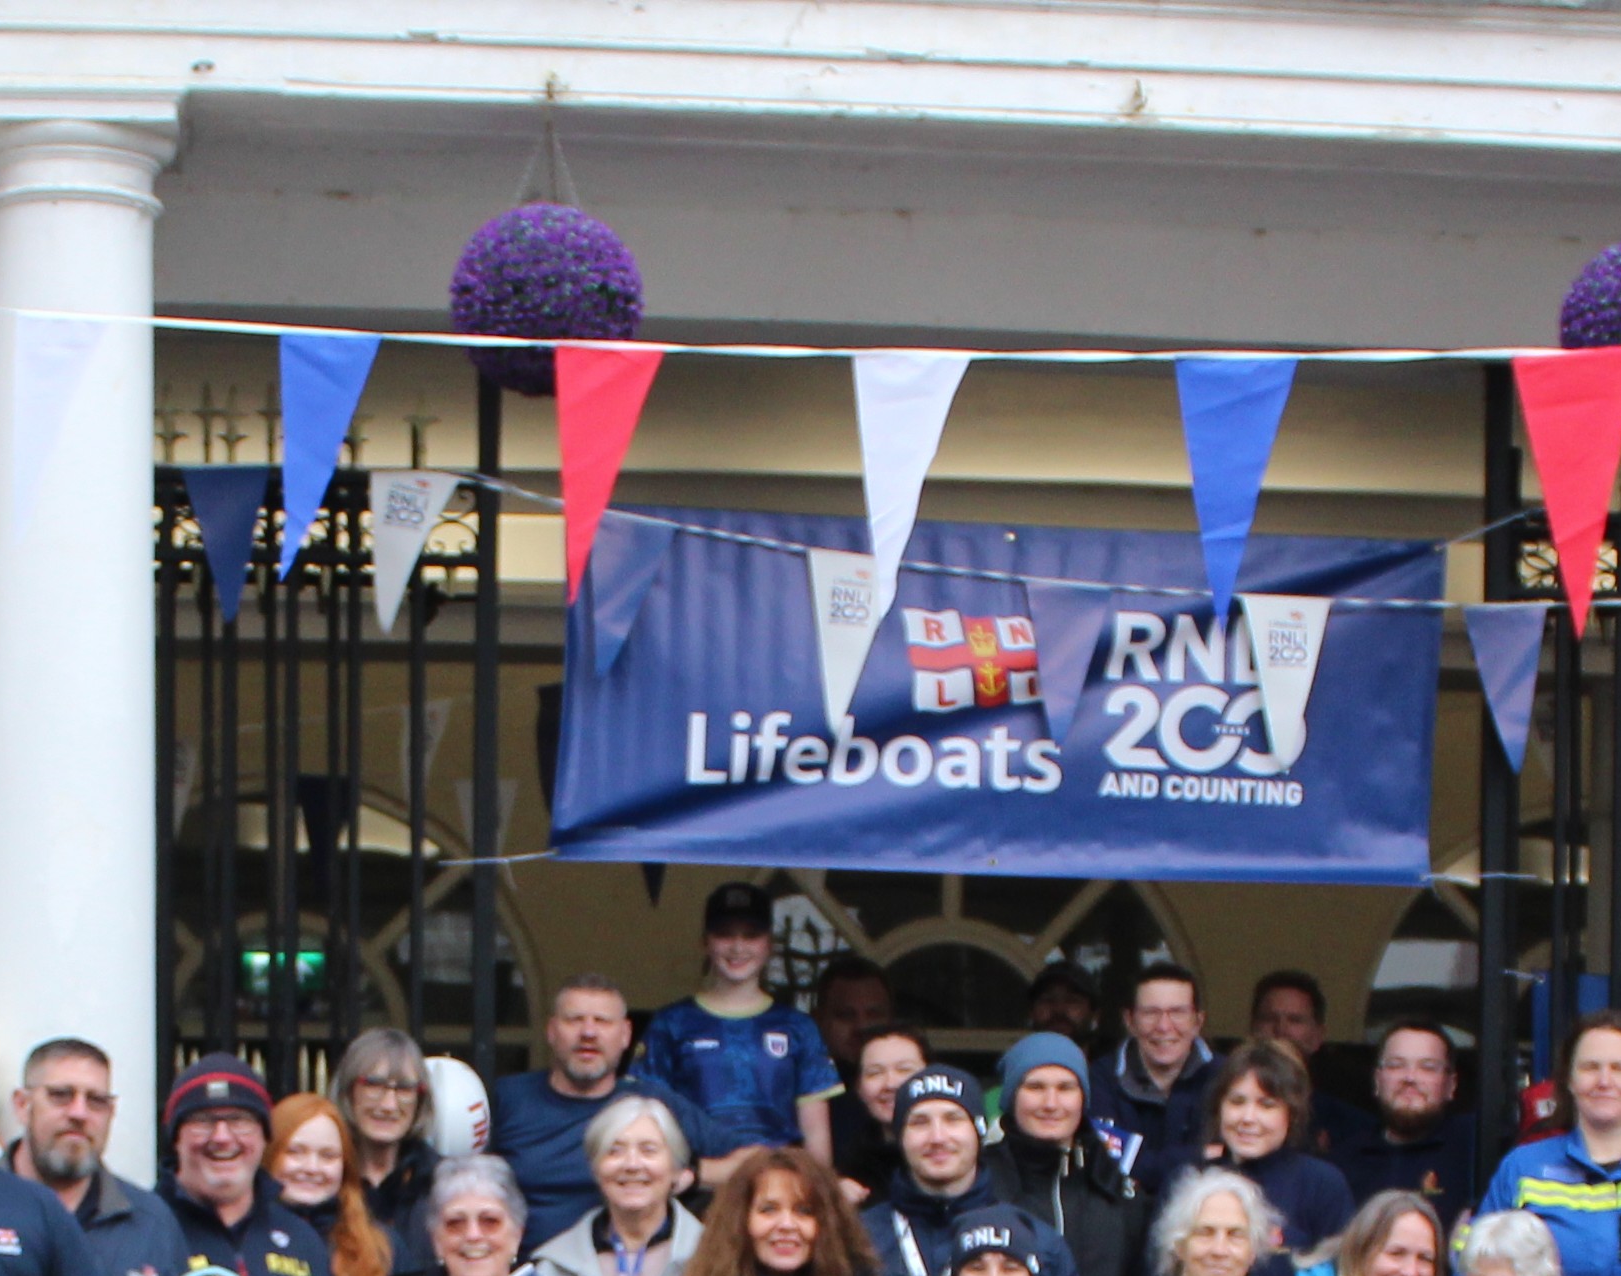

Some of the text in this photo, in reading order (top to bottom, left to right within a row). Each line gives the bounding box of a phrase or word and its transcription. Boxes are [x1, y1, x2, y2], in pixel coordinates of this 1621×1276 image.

[1104, 611, 1261, 684] RNL
[1269, 630, 1308, 646] RNLI
[1269, 645, 1308, 661] 200
[1213, 724, 1250, 737] YEARS
[685, 709, 1063, 794] Lifeboats
[1098, 771, 1304, 807] AND COUNTING
[908, 1067, 964, 1099] RNLI
[961, 1226, 1012, 1252] RNLI
